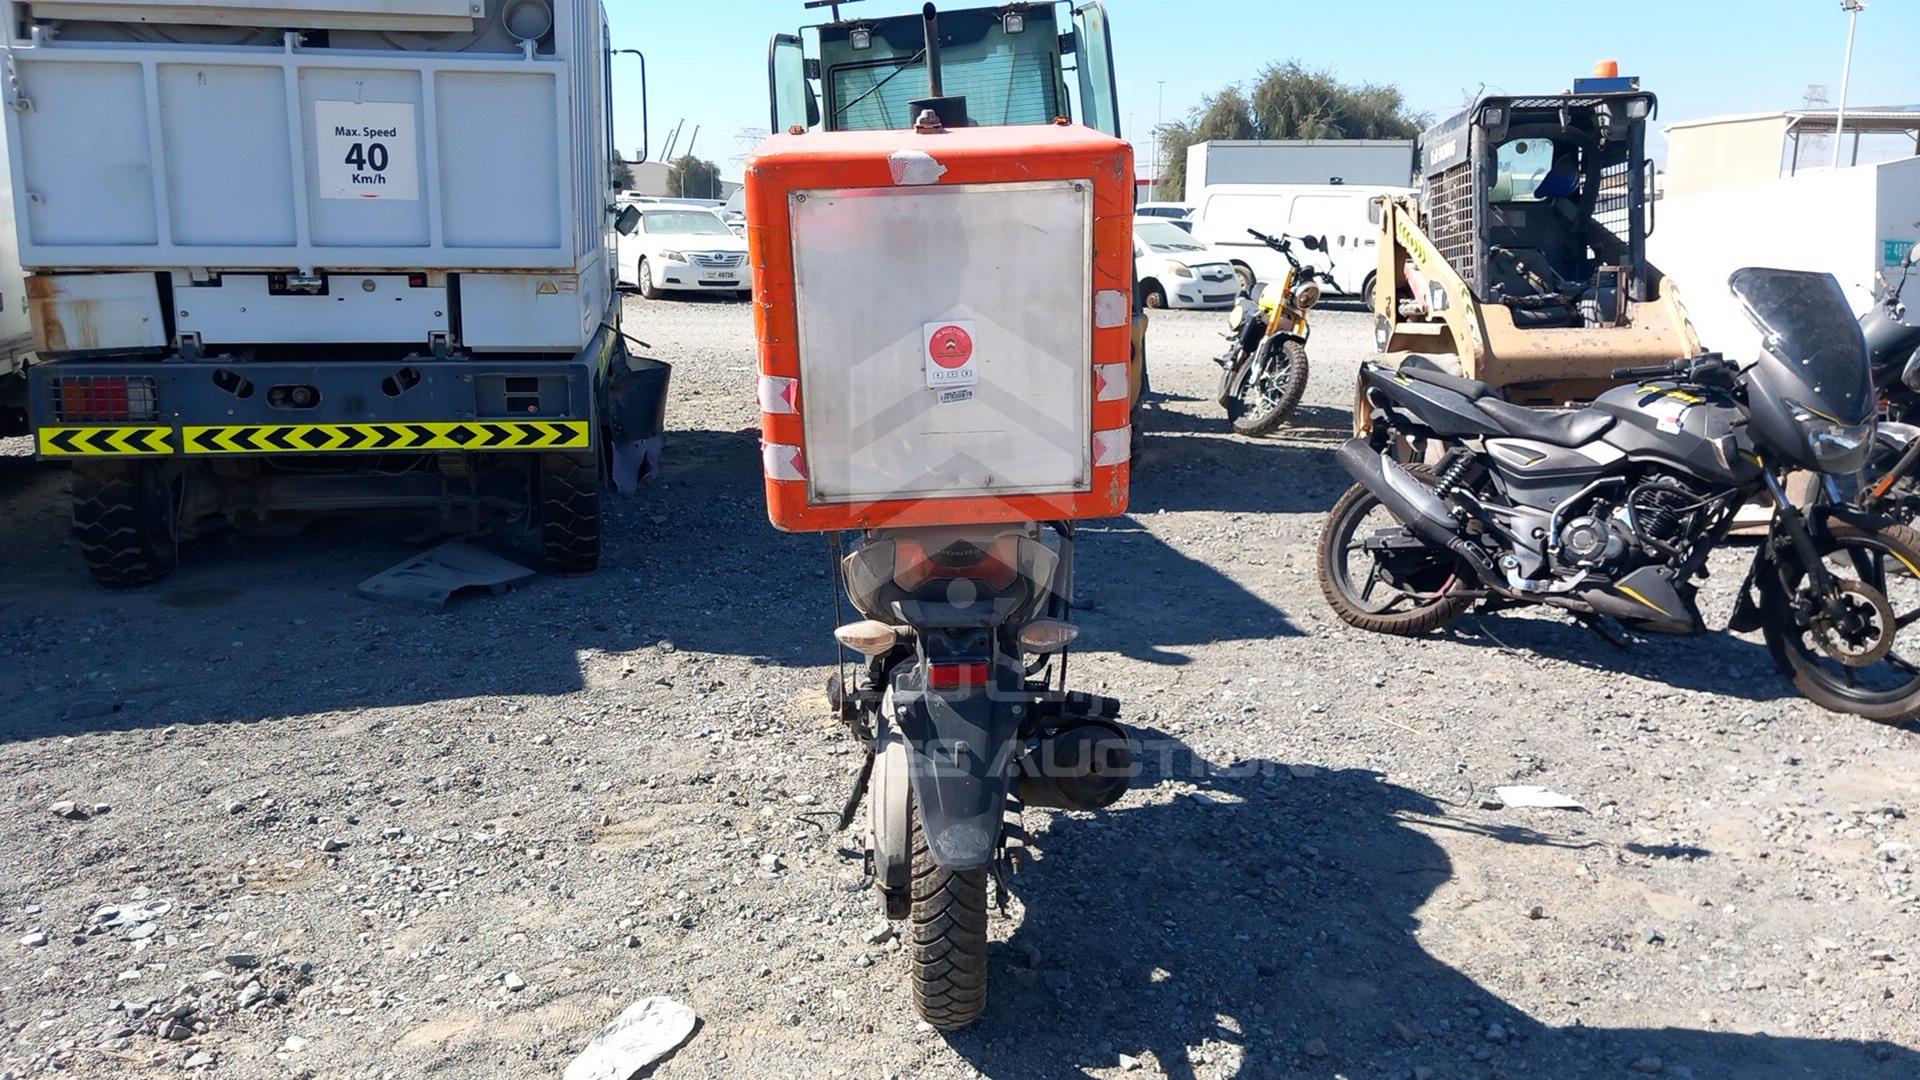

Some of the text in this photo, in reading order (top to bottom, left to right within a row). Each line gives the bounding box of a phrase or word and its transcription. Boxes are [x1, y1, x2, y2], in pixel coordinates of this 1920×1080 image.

[335, 126, 397, 139] Max. Speed
[345, 143, 388, 171] 40
[352, 174, 386, 184] Km/h
